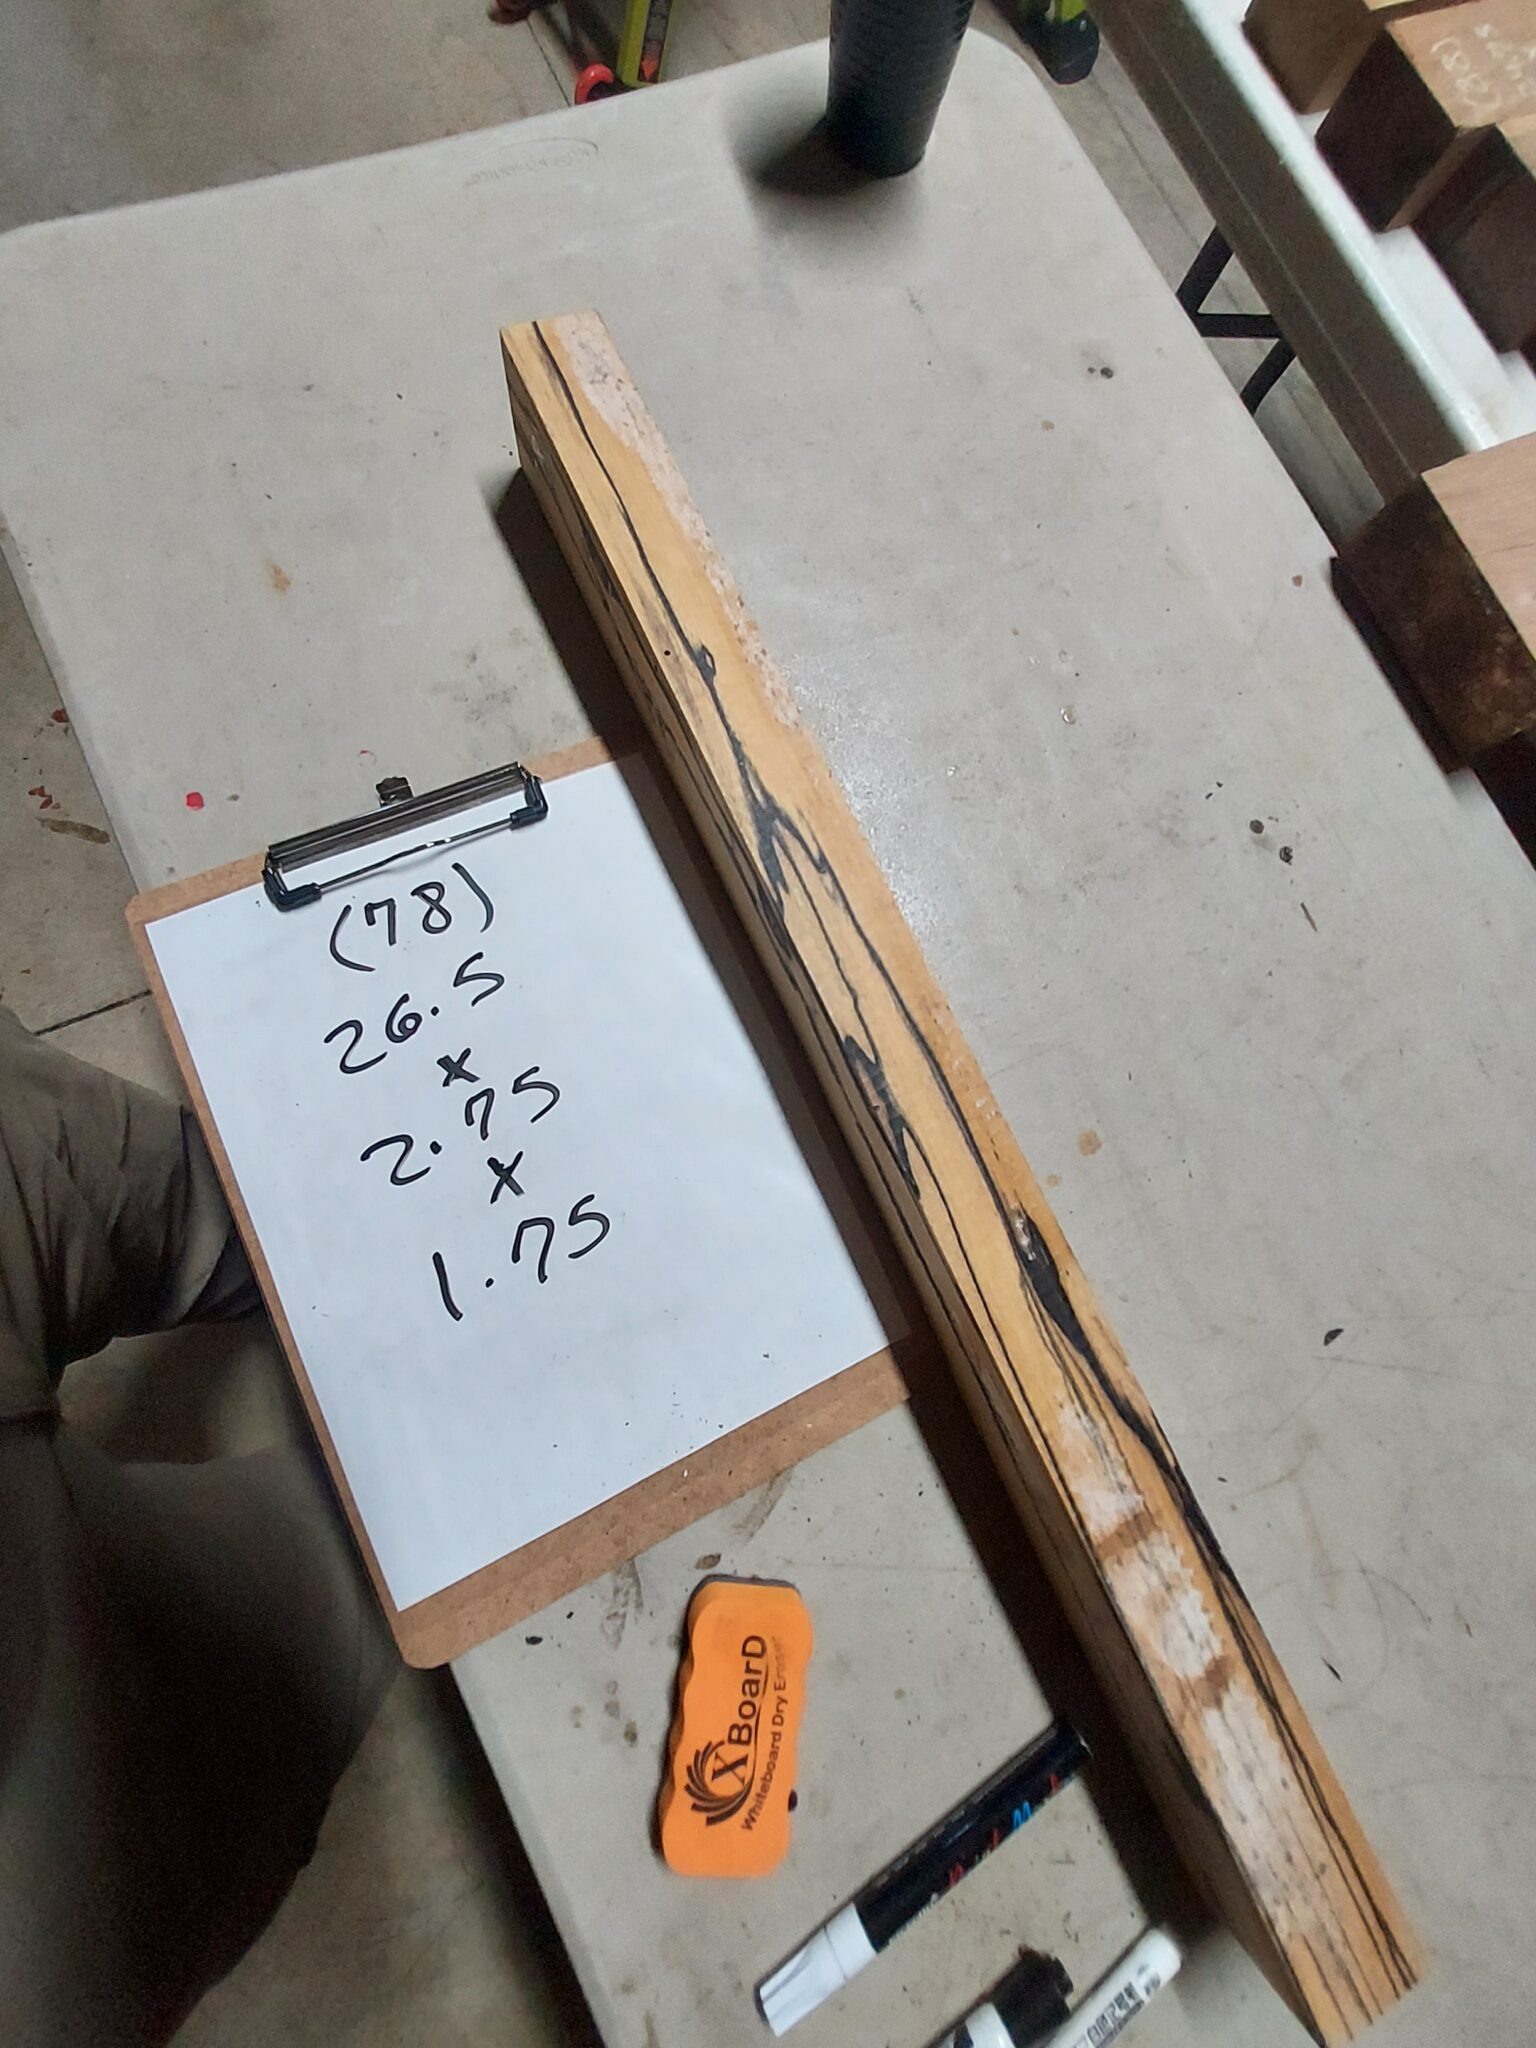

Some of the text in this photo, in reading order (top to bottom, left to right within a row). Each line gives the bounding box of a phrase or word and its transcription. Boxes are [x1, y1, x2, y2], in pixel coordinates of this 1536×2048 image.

[329, 862, 494, 972] (78)
[323, 951, 505, 1075] 26.5
[360, 1066, 561, 1186] 2.75
[432, 1193, 611, 1322] 1.75
[741, 1730, 782, 1831] Whiteboard
[771, 1696, 788, 1727] Dry
